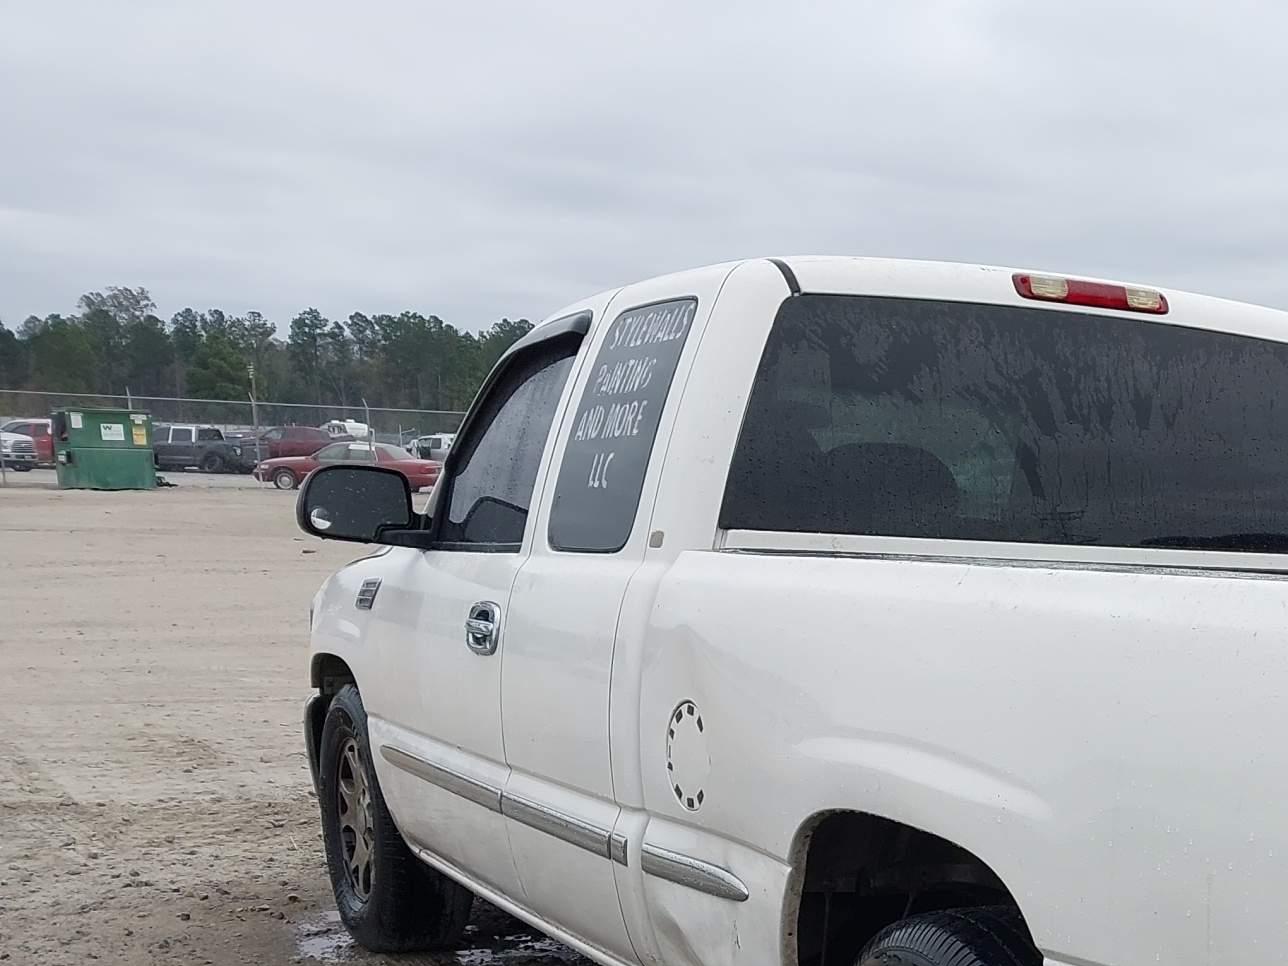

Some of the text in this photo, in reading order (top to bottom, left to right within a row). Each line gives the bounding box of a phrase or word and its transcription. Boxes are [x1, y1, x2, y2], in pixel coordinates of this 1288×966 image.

[574, 399, 648, 441] AND MORE
[588, 451, 616, 489] LLC
